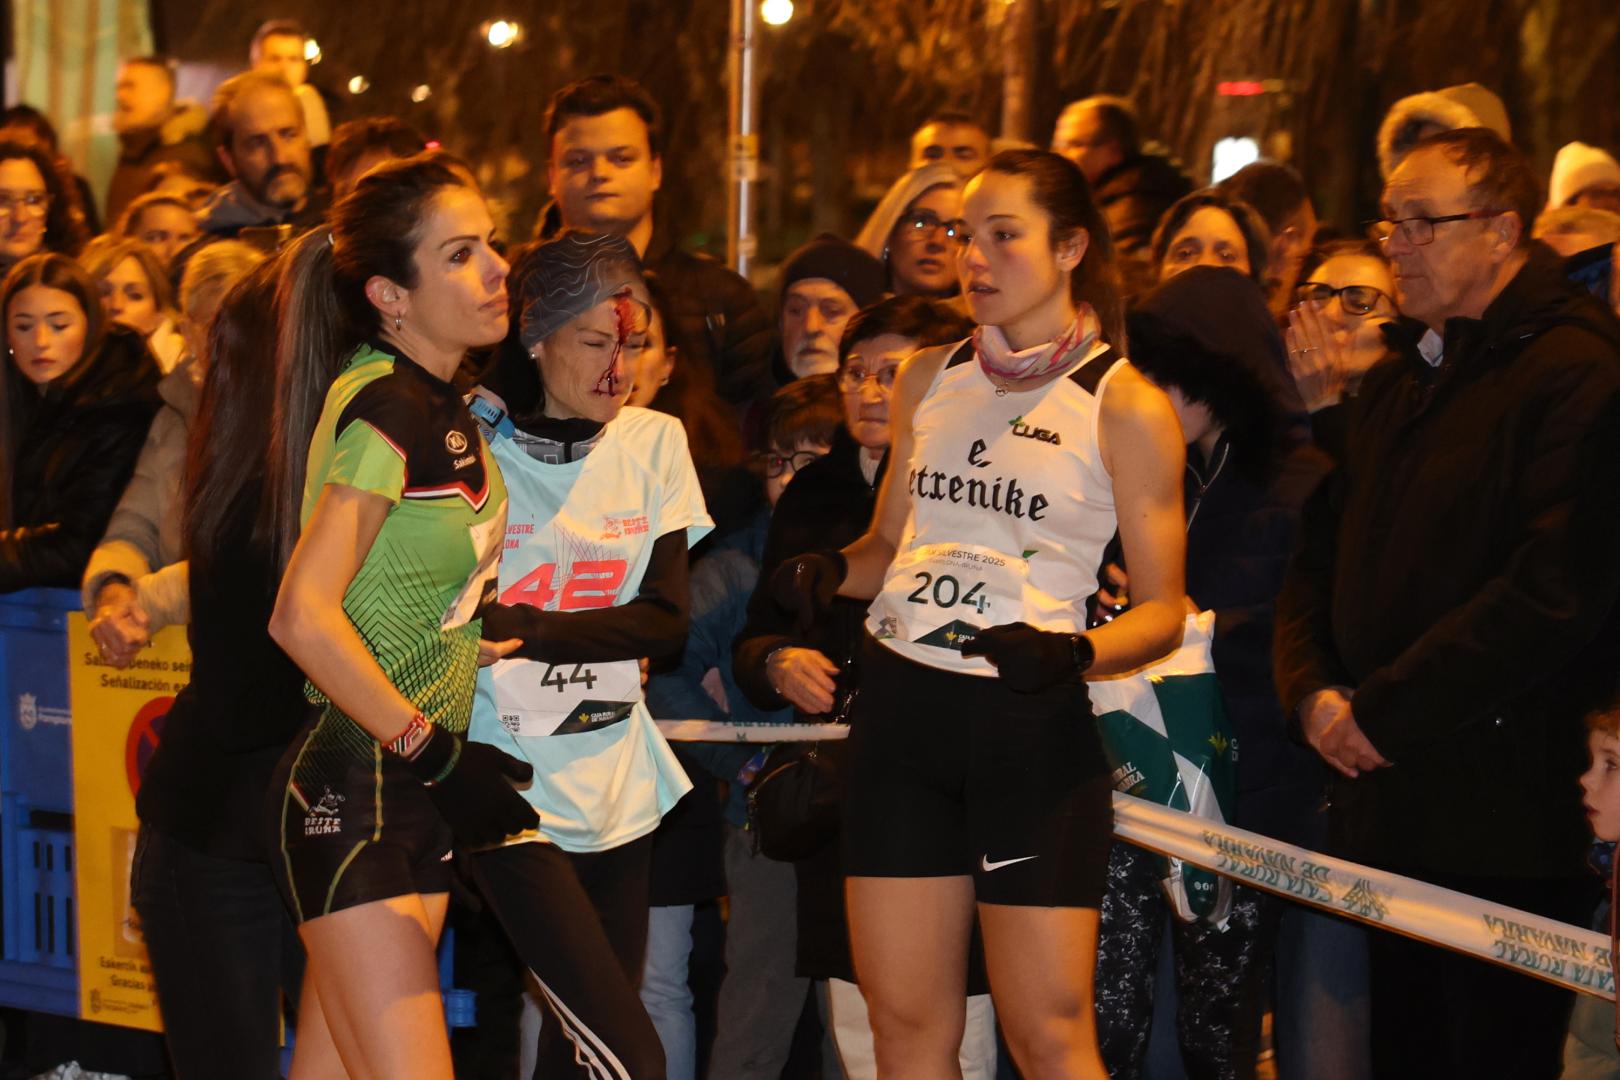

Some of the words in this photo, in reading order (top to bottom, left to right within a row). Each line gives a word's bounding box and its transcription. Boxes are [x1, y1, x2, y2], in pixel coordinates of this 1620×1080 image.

[981, 555, 1007, 567] 2025
[907, 571, 991, 614] 204
[541, 663, 598, 693] 44
[1217, 850, 1281, 886] RURAL
[1301, 861, 1330, 882] DE
[1286, 873, 1332, 902] CAJA
[1483, 914, 1588, 960] NAVARRA
[1494, 940, 1567, 977] RURAL
[1593, 946, 1612, 968] E
